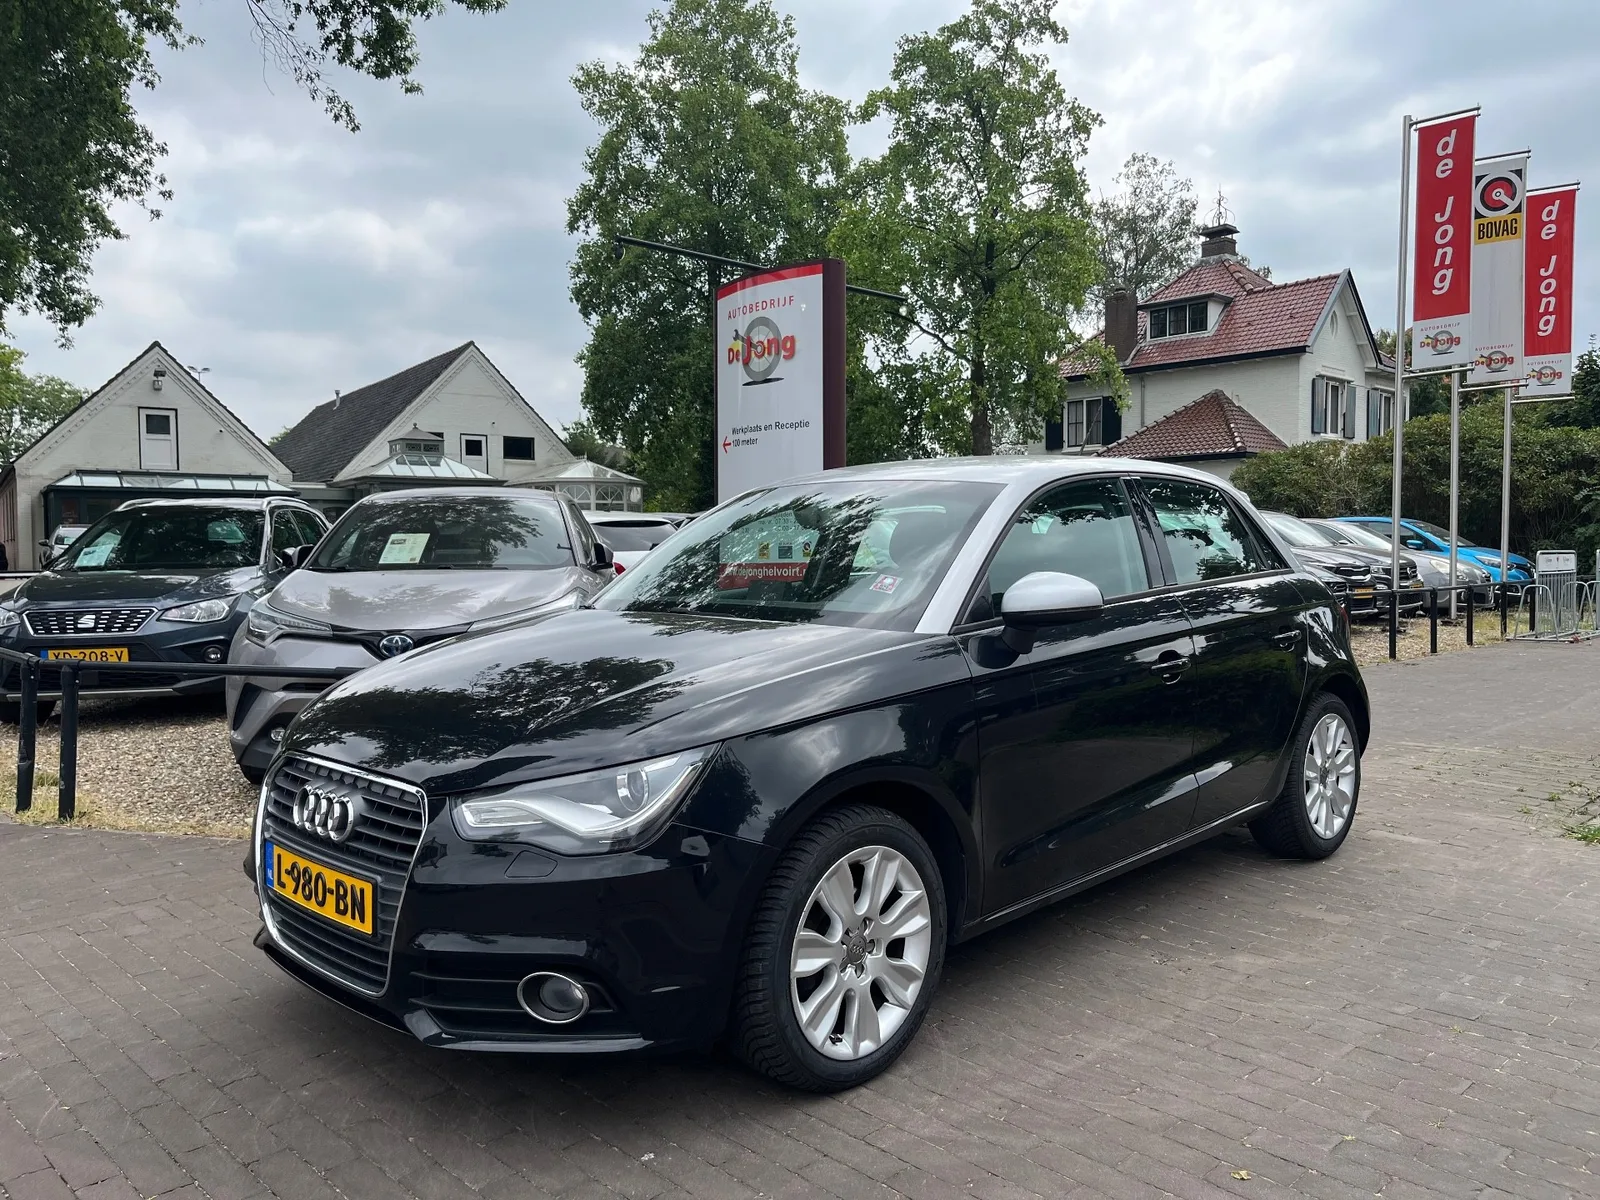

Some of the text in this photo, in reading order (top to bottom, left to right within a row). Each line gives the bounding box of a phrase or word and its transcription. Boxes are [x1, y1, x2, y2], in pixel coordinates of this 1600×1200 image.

[1435, 129, 1457, 179] de
[1477, 218, 1518, 240] BOVAG
[1541, 200, 1560, 240] de
[728, 295, 794, 320] AUTOBEDRIJF
[1420, 322, 1460, 332] AUTOBEDRIJF
[728, 334, 796, 365] De Jong
[732, 420, 810, 435] Werkplaats en Receptie
[732, 438, 758, 447] 100 meter
[276, 853, 365, 924] L-980-BN
